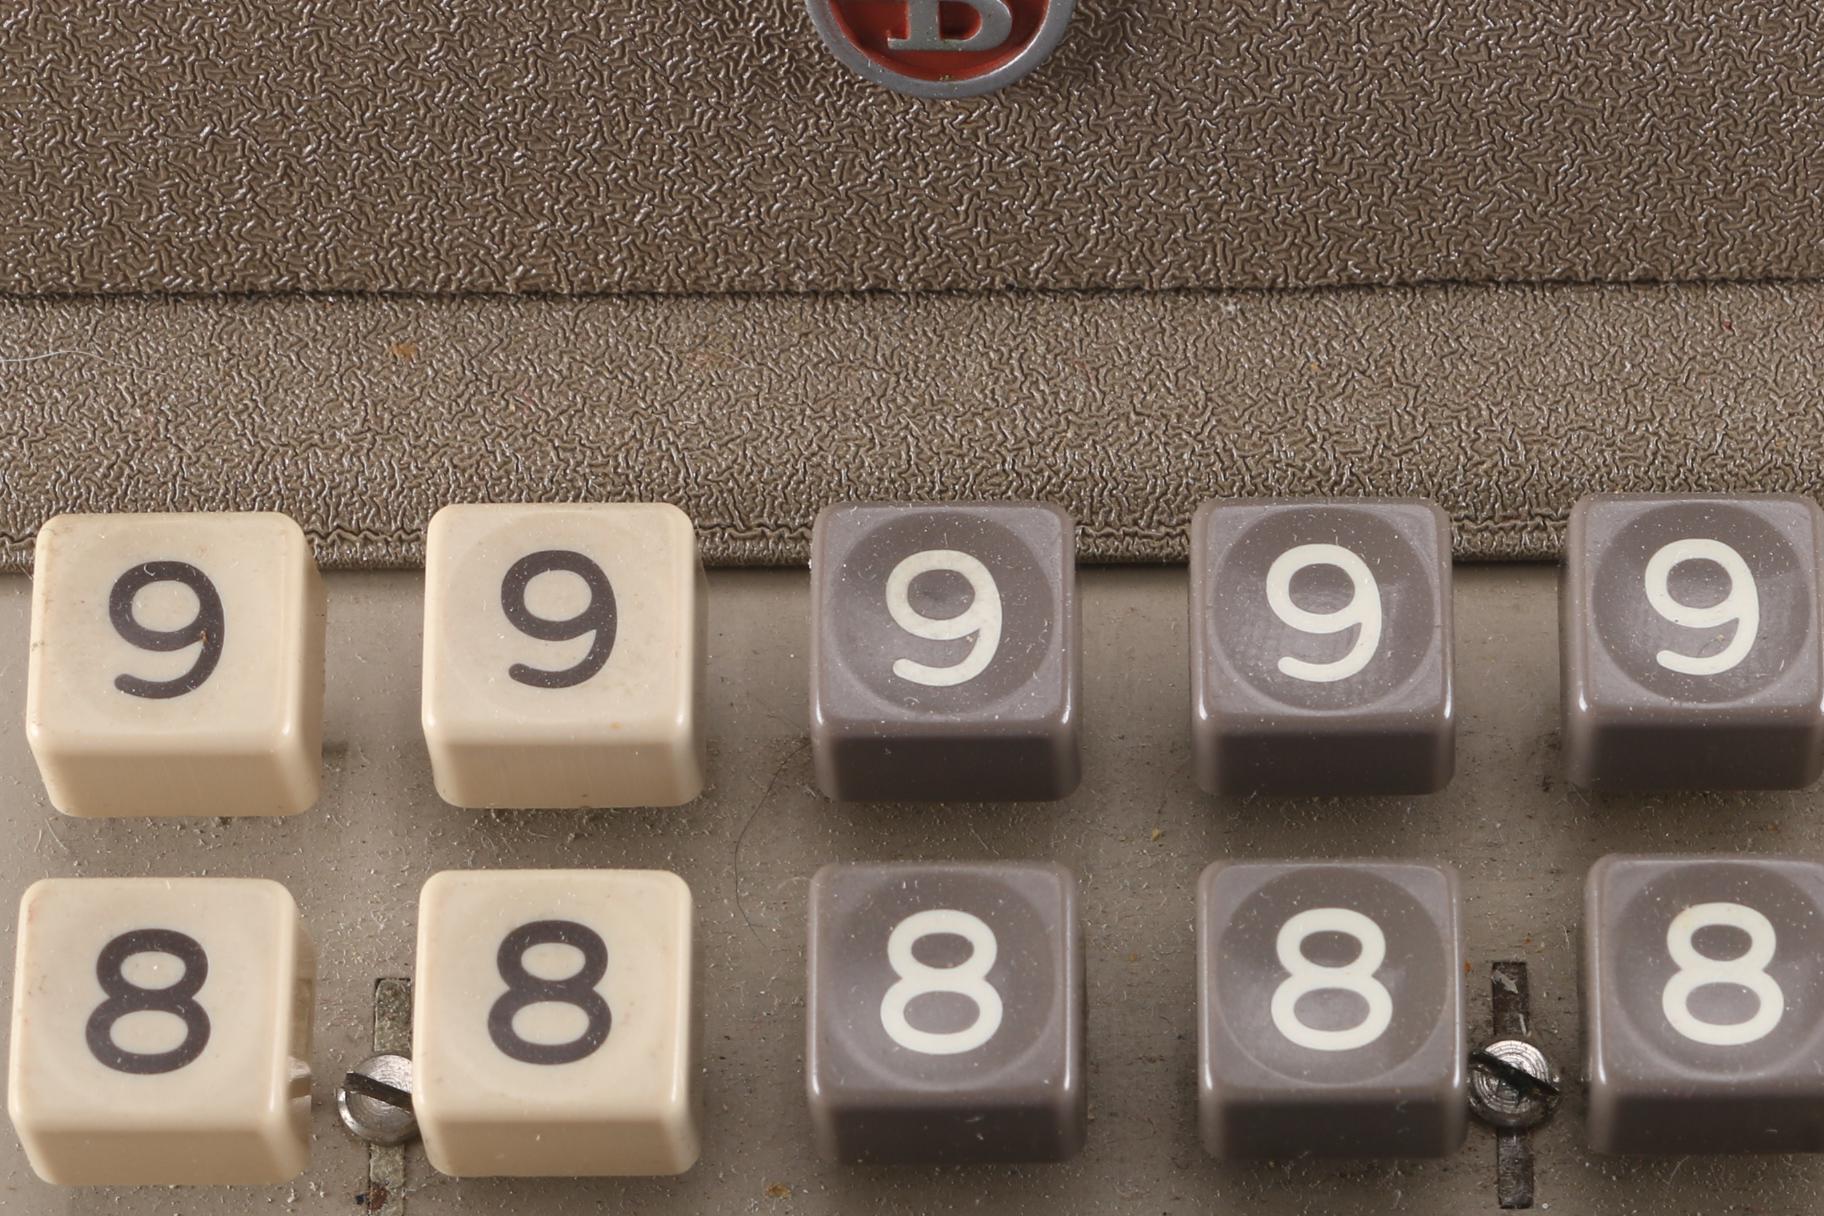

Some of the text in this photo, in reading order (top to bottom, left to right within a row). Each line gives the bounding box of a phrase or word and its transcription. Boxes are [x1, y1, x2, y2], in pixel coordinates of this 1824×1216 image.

[109, 561, 224, 699] 9
[501, 550, 617, 689] 9
[886, 550, 1002, 686] 9
[1266, 544, 1382, 682] 9
[1645, 539, 1759, 675] 9
[86, 929, 210, 1075] 8
[488, 920, 612, 1065] 8
[880, 910, 1003, 1055] 8
[1271, 908, 1392, 1051] 8
[1662, 903, 1784, 1045] 8
